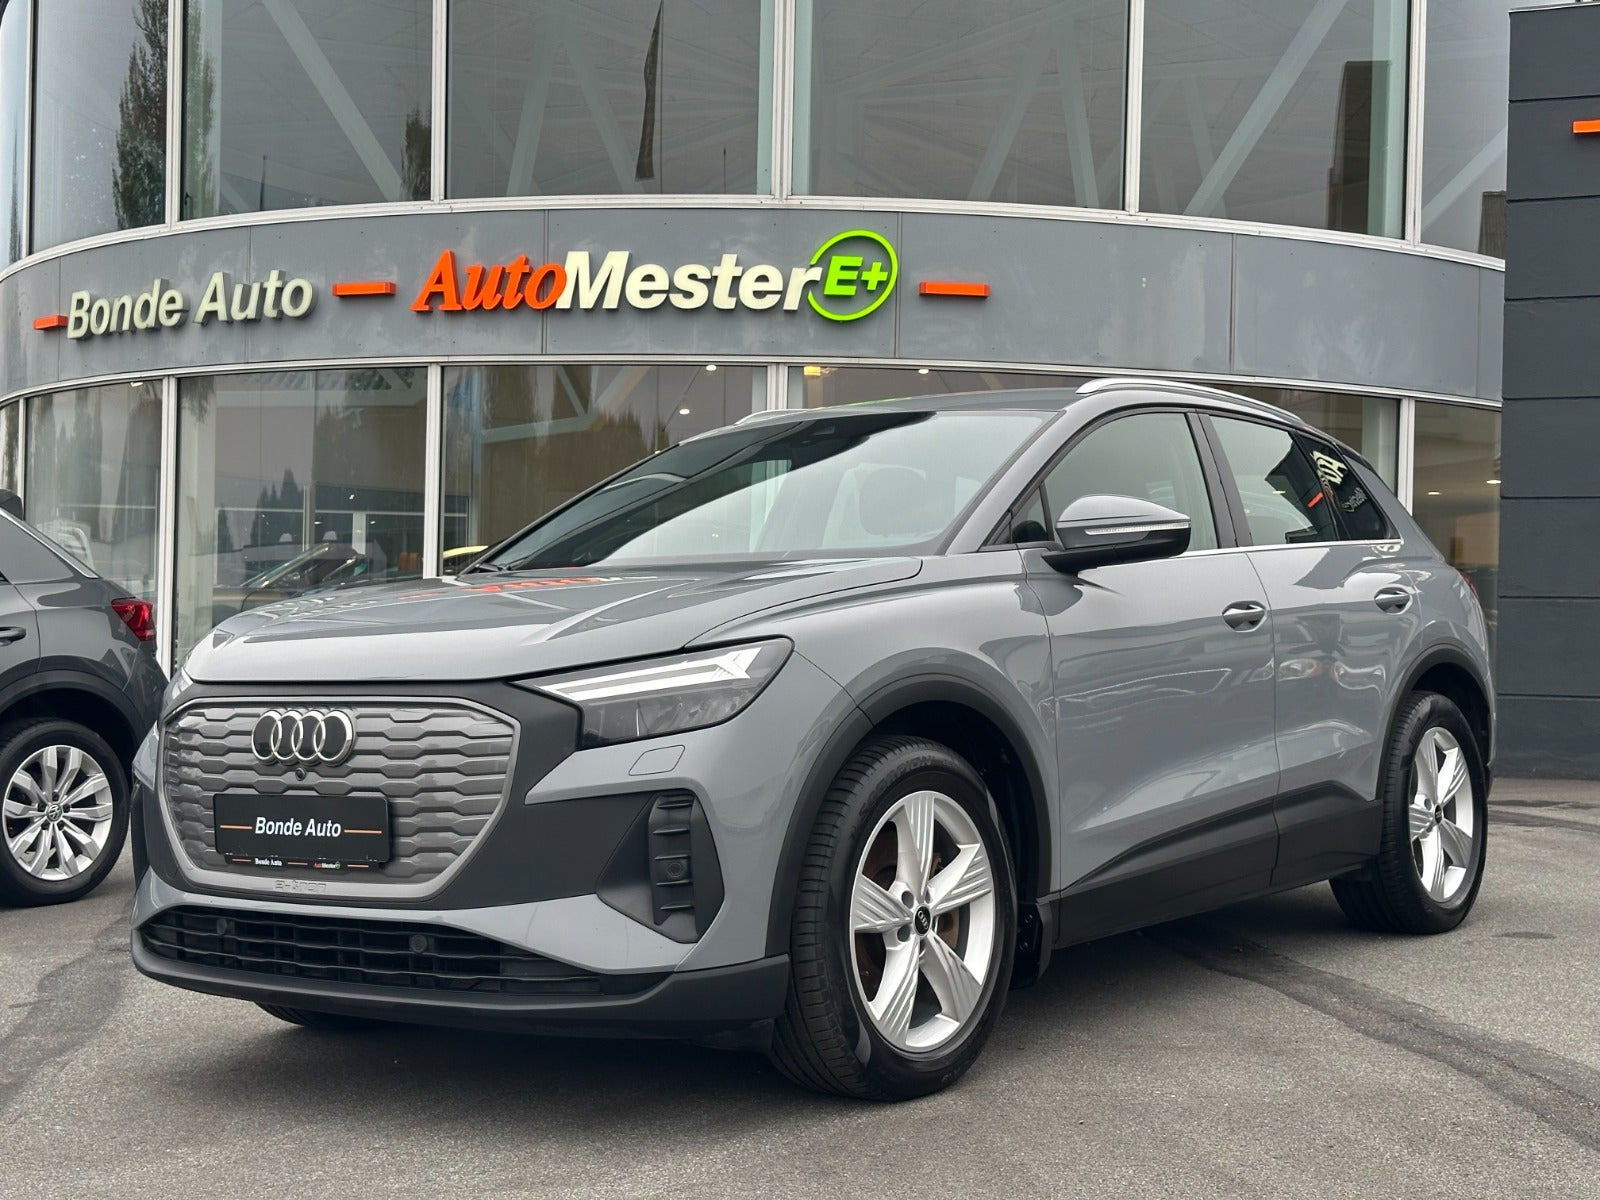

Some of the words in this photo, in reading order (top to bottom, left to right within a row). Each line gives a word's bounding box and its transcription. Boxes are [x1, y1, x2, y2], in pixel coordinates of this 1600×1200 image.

[67, 278, 185, 340] Bonde
[193, 269, 315, 326] Auto
[255, 816, 302, 836] Bonde
[304, 818, 341, 837] Auto
